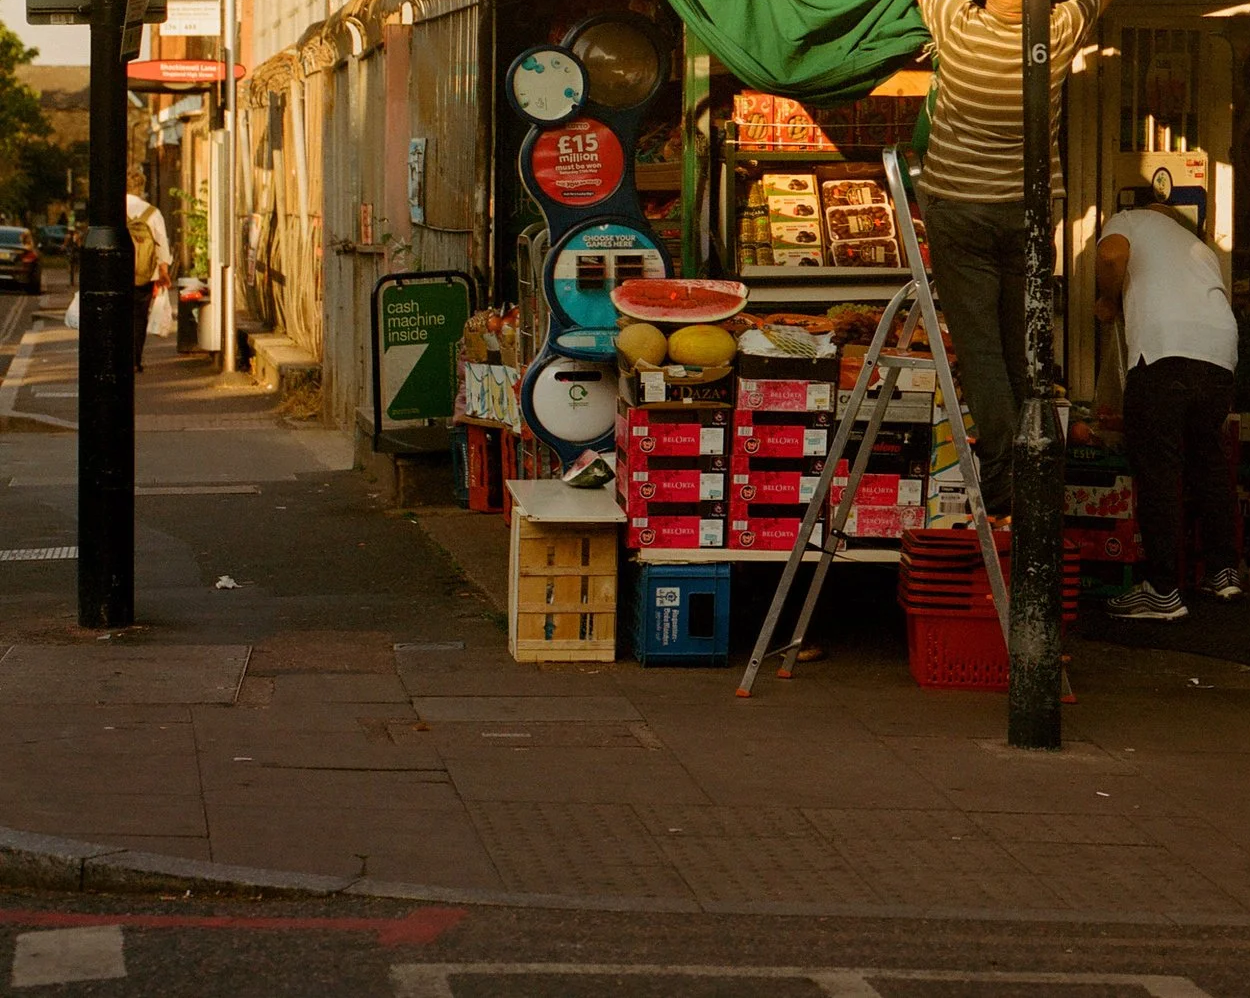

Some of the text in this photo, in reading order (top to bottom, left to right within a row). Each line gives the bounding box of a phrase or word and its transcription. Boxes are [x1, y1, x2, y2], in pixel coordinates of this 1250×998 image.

[1032, 43, 1047, 64] 6
[557, 133, 598, 154] £15
[559, 153, 598, 163] million
[387, 299, 419, 314] cash
[388, 312, 445, 328] machine
[388, 327, 428, 342] inside
[680, 386, 721, 399] DAZA
[663, 435, 695, 444] BELORTA
[767, 436, 799, 446] BELORTA
[663, 480, 695, 490] BELORTA
[763, 483, 795, 493] BELORTA
[662, 527, 695, 536] BELORTA
[762, 529, 794, 539] BELORTA
